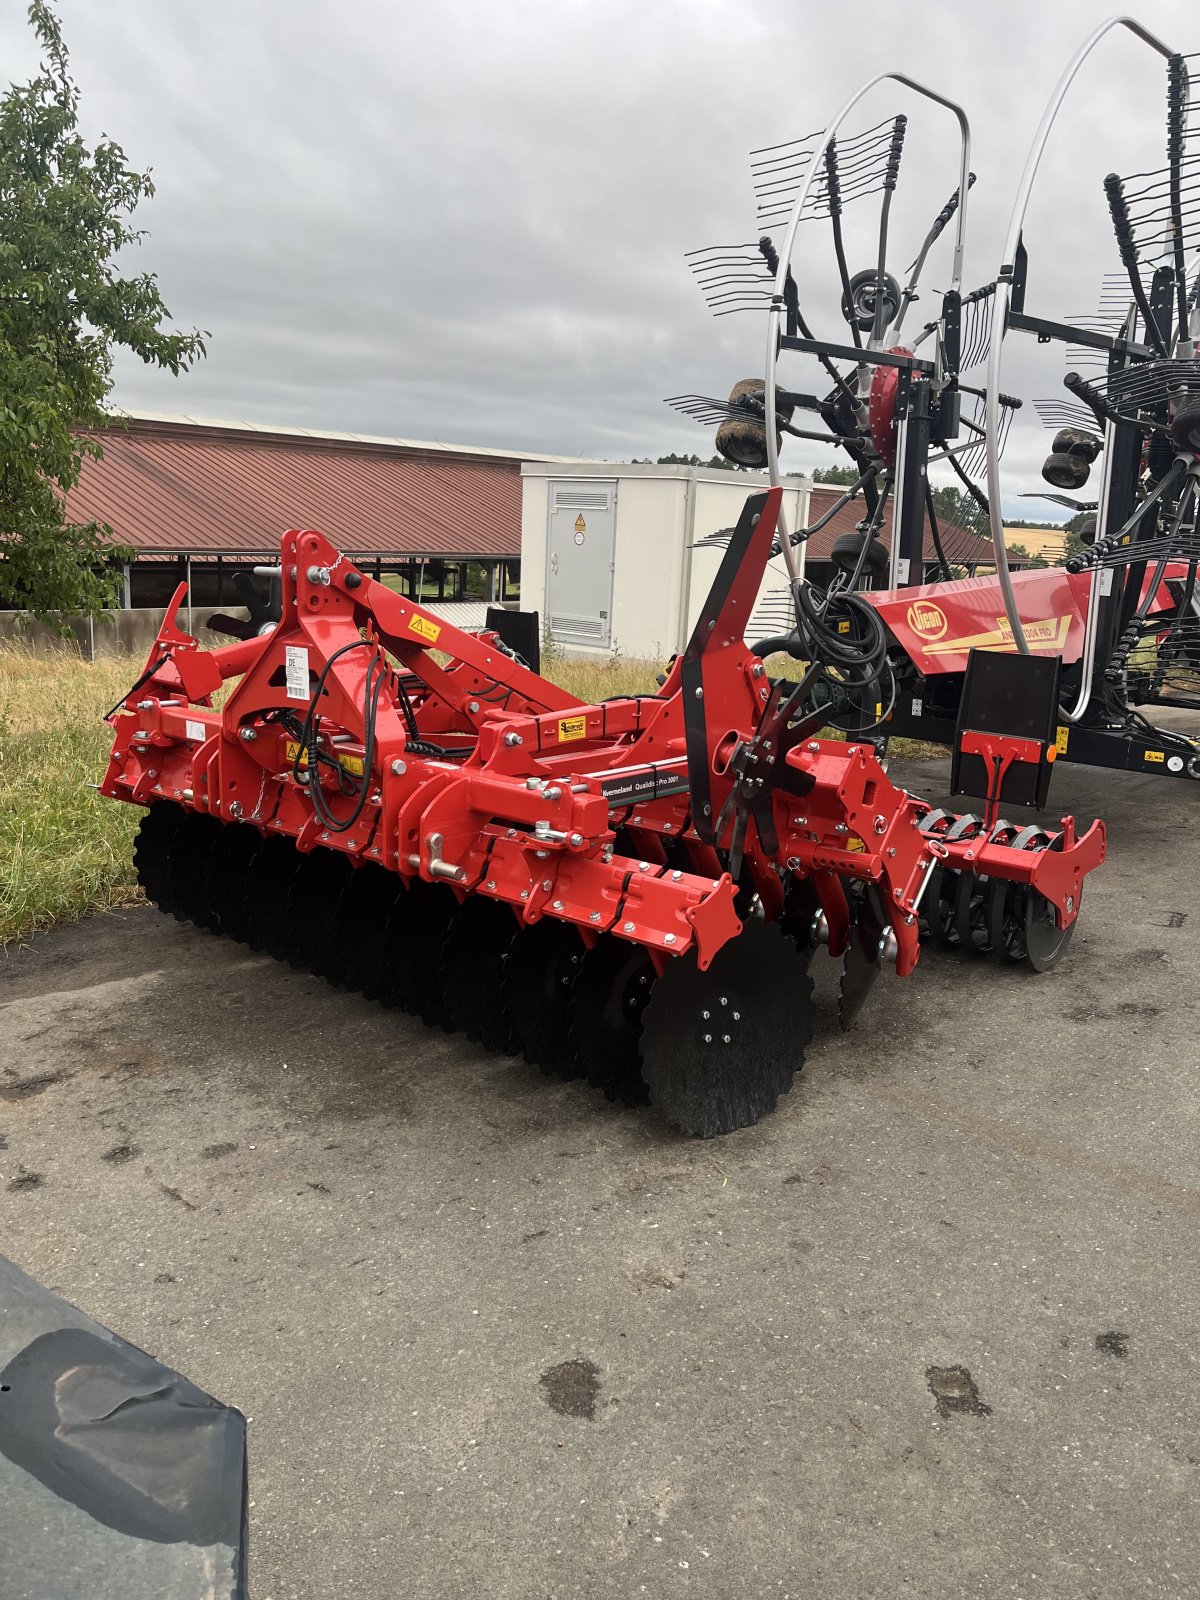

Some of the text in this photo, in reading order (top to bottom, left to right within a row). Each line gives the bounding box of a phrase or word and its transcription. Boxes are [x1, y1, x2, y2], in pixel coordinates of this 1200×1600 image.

[910, 605, 944, 632] Vicon
[1039, 627, 1051, 637] PRO
[288, 658, 295, 667] DE
[602, 785, 633, 797] Kverneland
[658, 778, 668, 786] Pro
